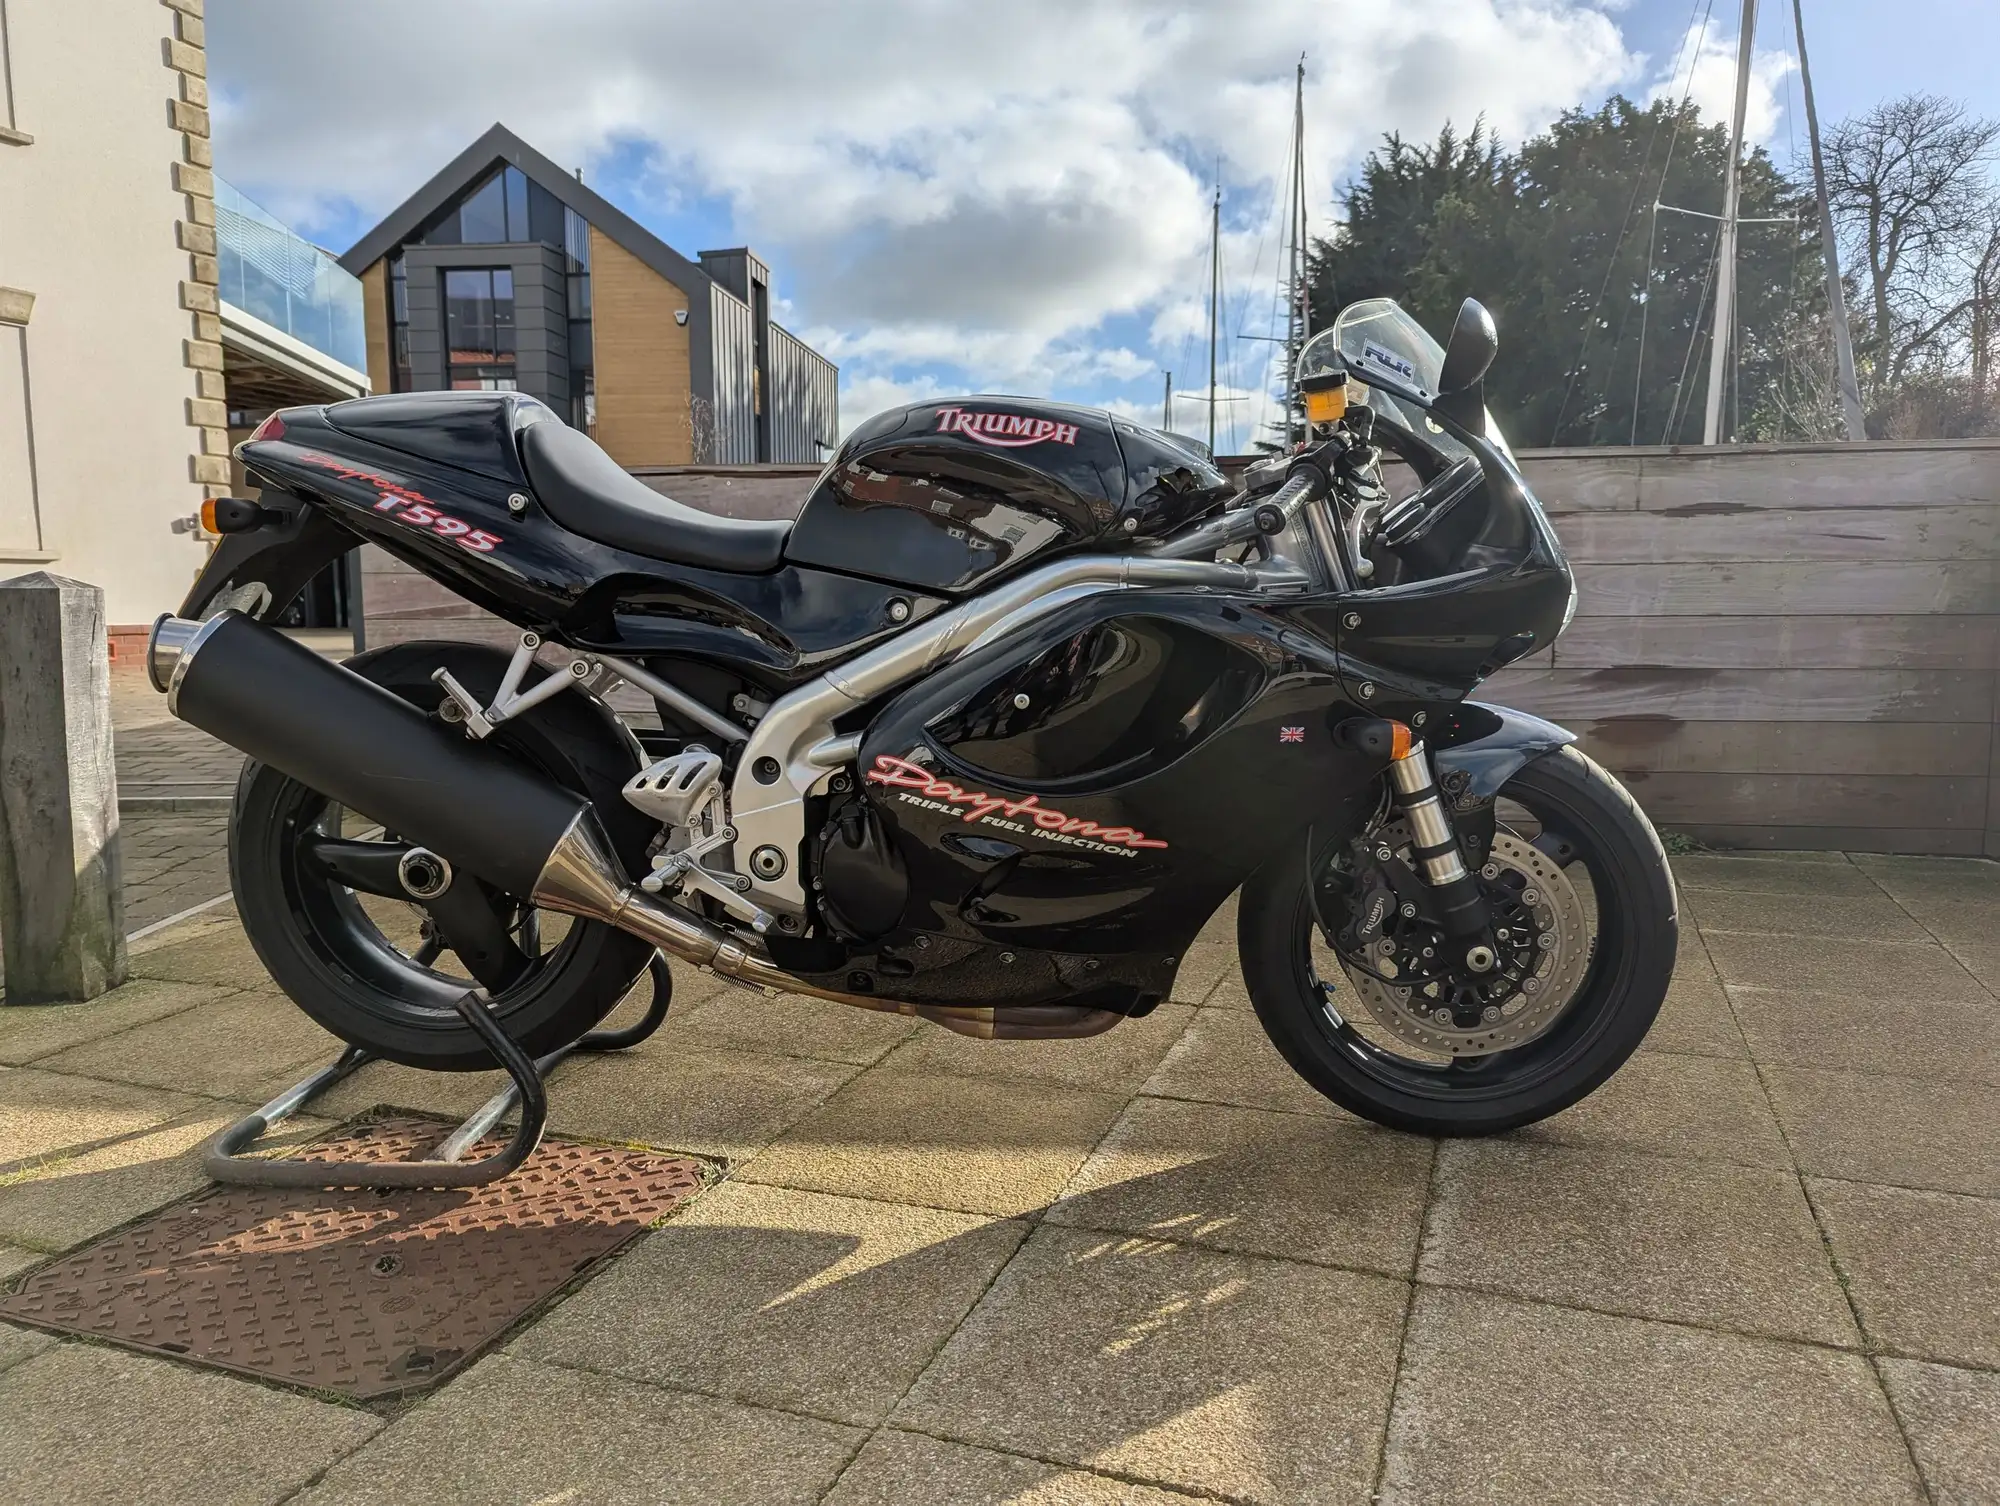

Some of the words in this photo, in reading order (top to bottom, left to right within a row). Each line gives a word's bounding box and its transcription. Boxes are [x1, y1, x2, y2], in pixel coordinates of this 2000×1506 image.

[935, 407, 1080, 447] TRIUMPH
[299, 453, 435, 504] Daytona
[373, 491, 504, 552] T595
[867, 754, 1169, 848] Daytona
[898, 793, 964, 817] TRIPLE
[980, 815, 1026, 834] FUEL
[1030, 827, 1138, 858] INJECTION
[1361, 897, 1385, 935] TRIUMPH
